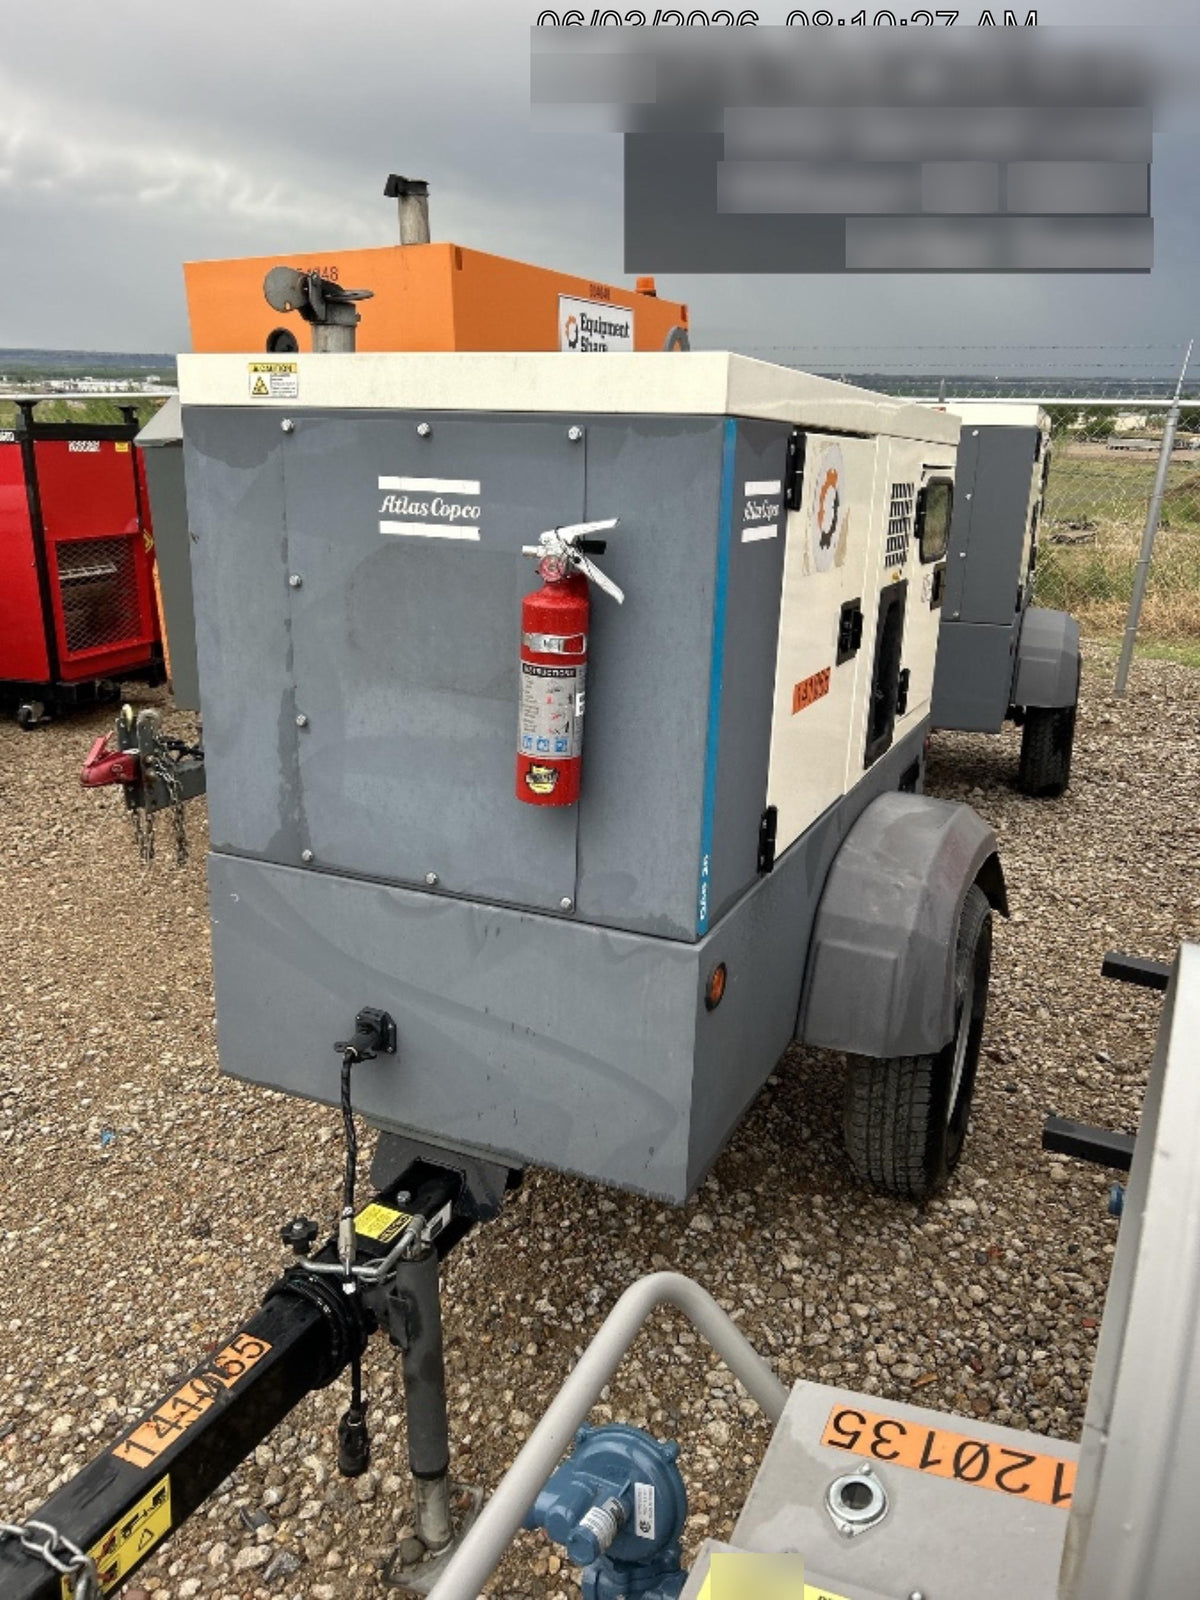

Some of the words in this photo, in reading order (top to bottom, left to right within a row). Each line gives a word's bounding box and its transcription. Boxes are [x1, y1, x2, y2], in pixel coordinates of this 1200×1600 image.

[580, 312, 630, 339] Equipment
[378, 495, 429, 517] Atlas
[430, 496, 481, 522] Copco
[827, 1409, 1073, 1505] 120135
